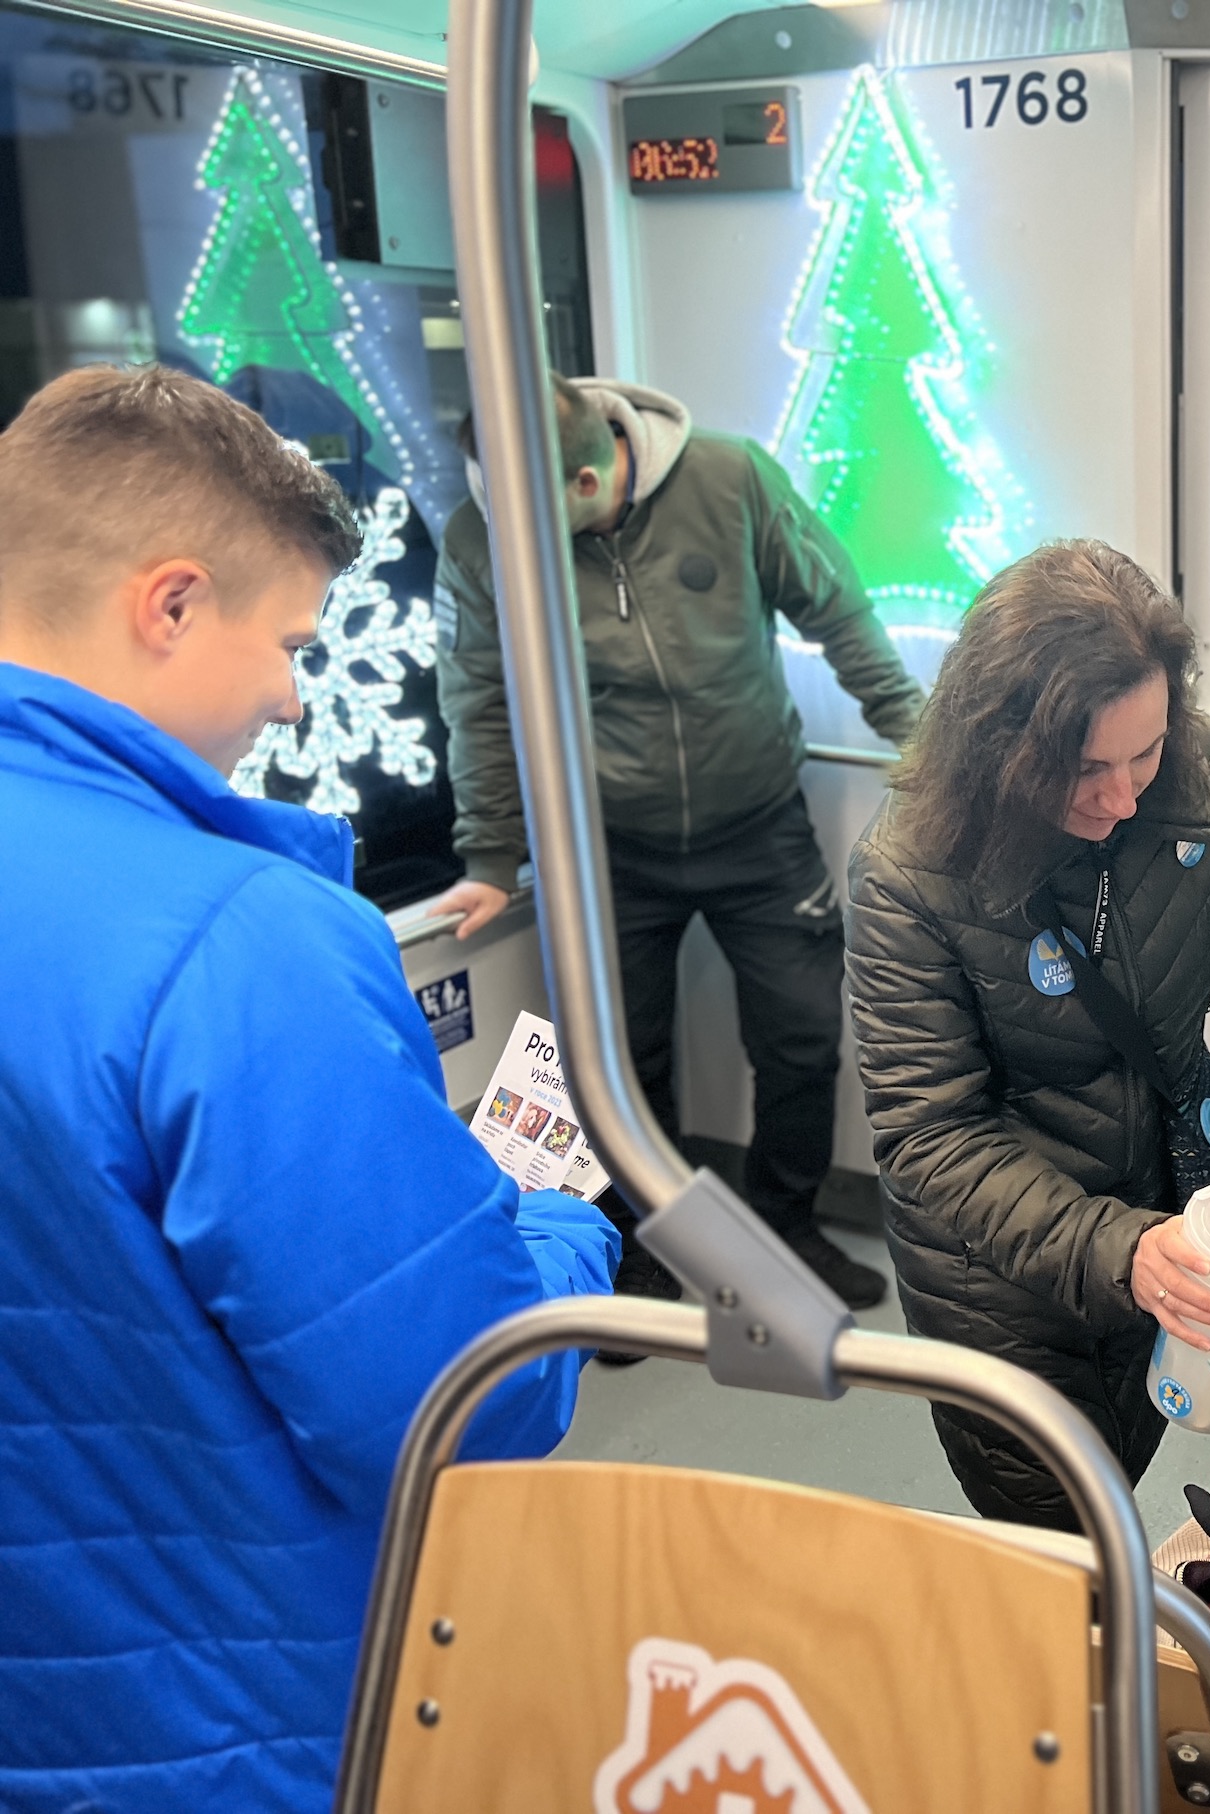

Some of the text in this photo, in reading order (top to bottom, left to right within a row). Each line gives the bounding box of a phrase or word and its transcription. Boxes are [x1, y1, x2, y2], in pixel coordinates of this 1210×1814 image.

[954, 67, 1088, 130] 1768
[764, 102, 788, 145] 2
[1093, 912, 1107, 955] APPAREL
[1041, 978, 1050, 989] V
[1044, 960, 1072, 978] LÍTÁM
[524, 1032, 555, 1062] Pro
[531, 1067, 569, 1095] vybírám
[1162, 1398, 1178, 1415] dpo
